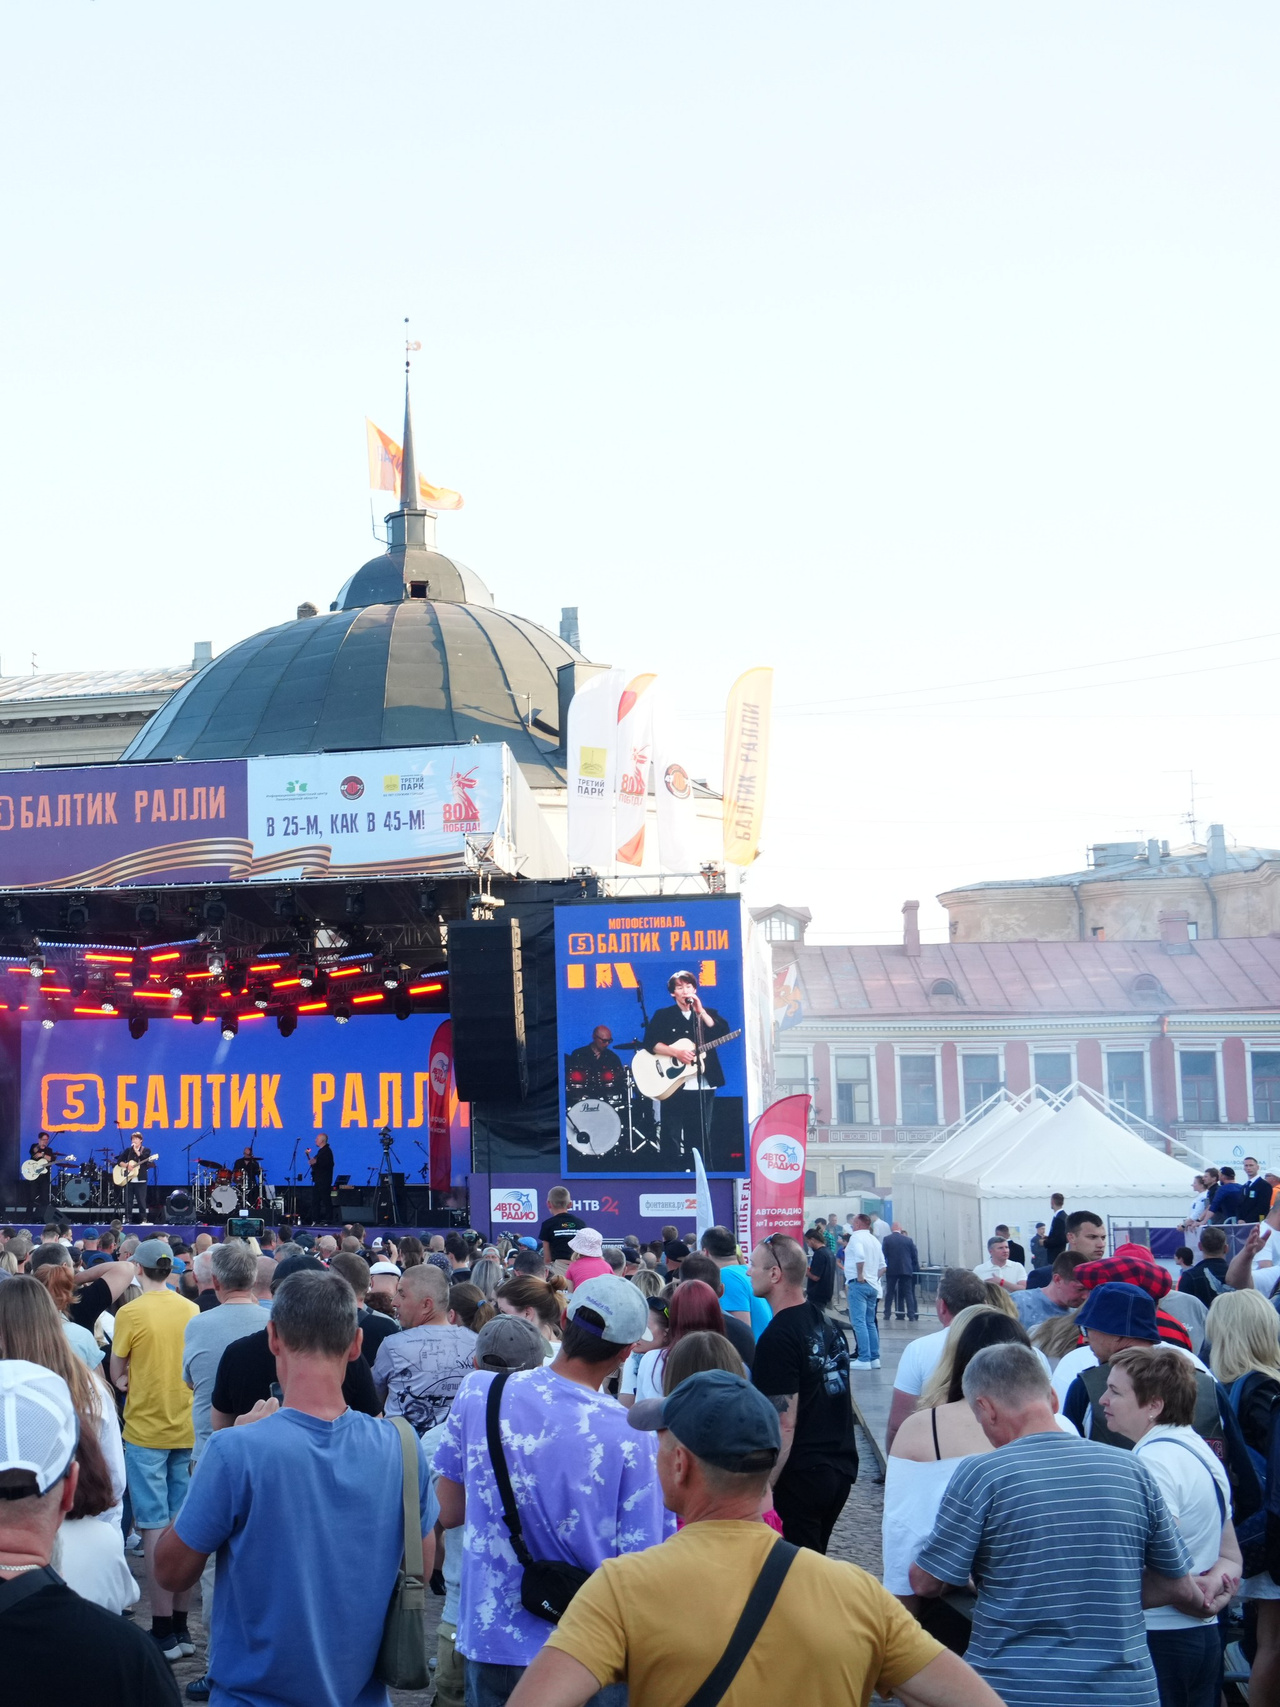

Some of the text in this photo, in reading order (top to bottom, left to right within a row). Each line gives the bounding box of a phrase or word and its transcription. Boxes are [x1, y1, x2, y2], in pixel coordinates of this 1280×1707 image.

[735, 702, 760, 841] БАЛТИК РАЛЛИ
[401, 775, 424, 783] ТРЕТИЙ
[578, 777, 605, 788] ТРЕТИЙ
[577, 785, 604, 797] ПАРК
[20, 792, 118, 829] БАЛТИК
[135, 786, 226, 823] РАЛЛИ
[443, 803, 462, 821] 80
[267, 810, 425, 839] В 25-М, КАК В 45-М!
[443, 822, 480, 833] ПОБЕДА!
[609, 916, 686, 930] МОТОФЕСТИВАЛЬ
[597, 932, 660, 953] БАЛТИК
[670, 929, 729, 951] РАЛЛИ
[117, 1073, 283, 1129] БАЛТИК
[761, 1153, 786, 1162] АВТО
[768, 1161, 800, 1171] РАДИО
[493, 1203, 521, 1212] АВТО
[583, 1200, 600, 1211] ТВ
[601, 1196, 619, 1215] 24
[645, 1200, 685, 1211] фонтанка.ру
[501, 1211, 536, 1220] РАДИО
[755, 1208, 802, 1216] АВТОРАДИО
[774, 1219, 801, 1227] РОССИИ
